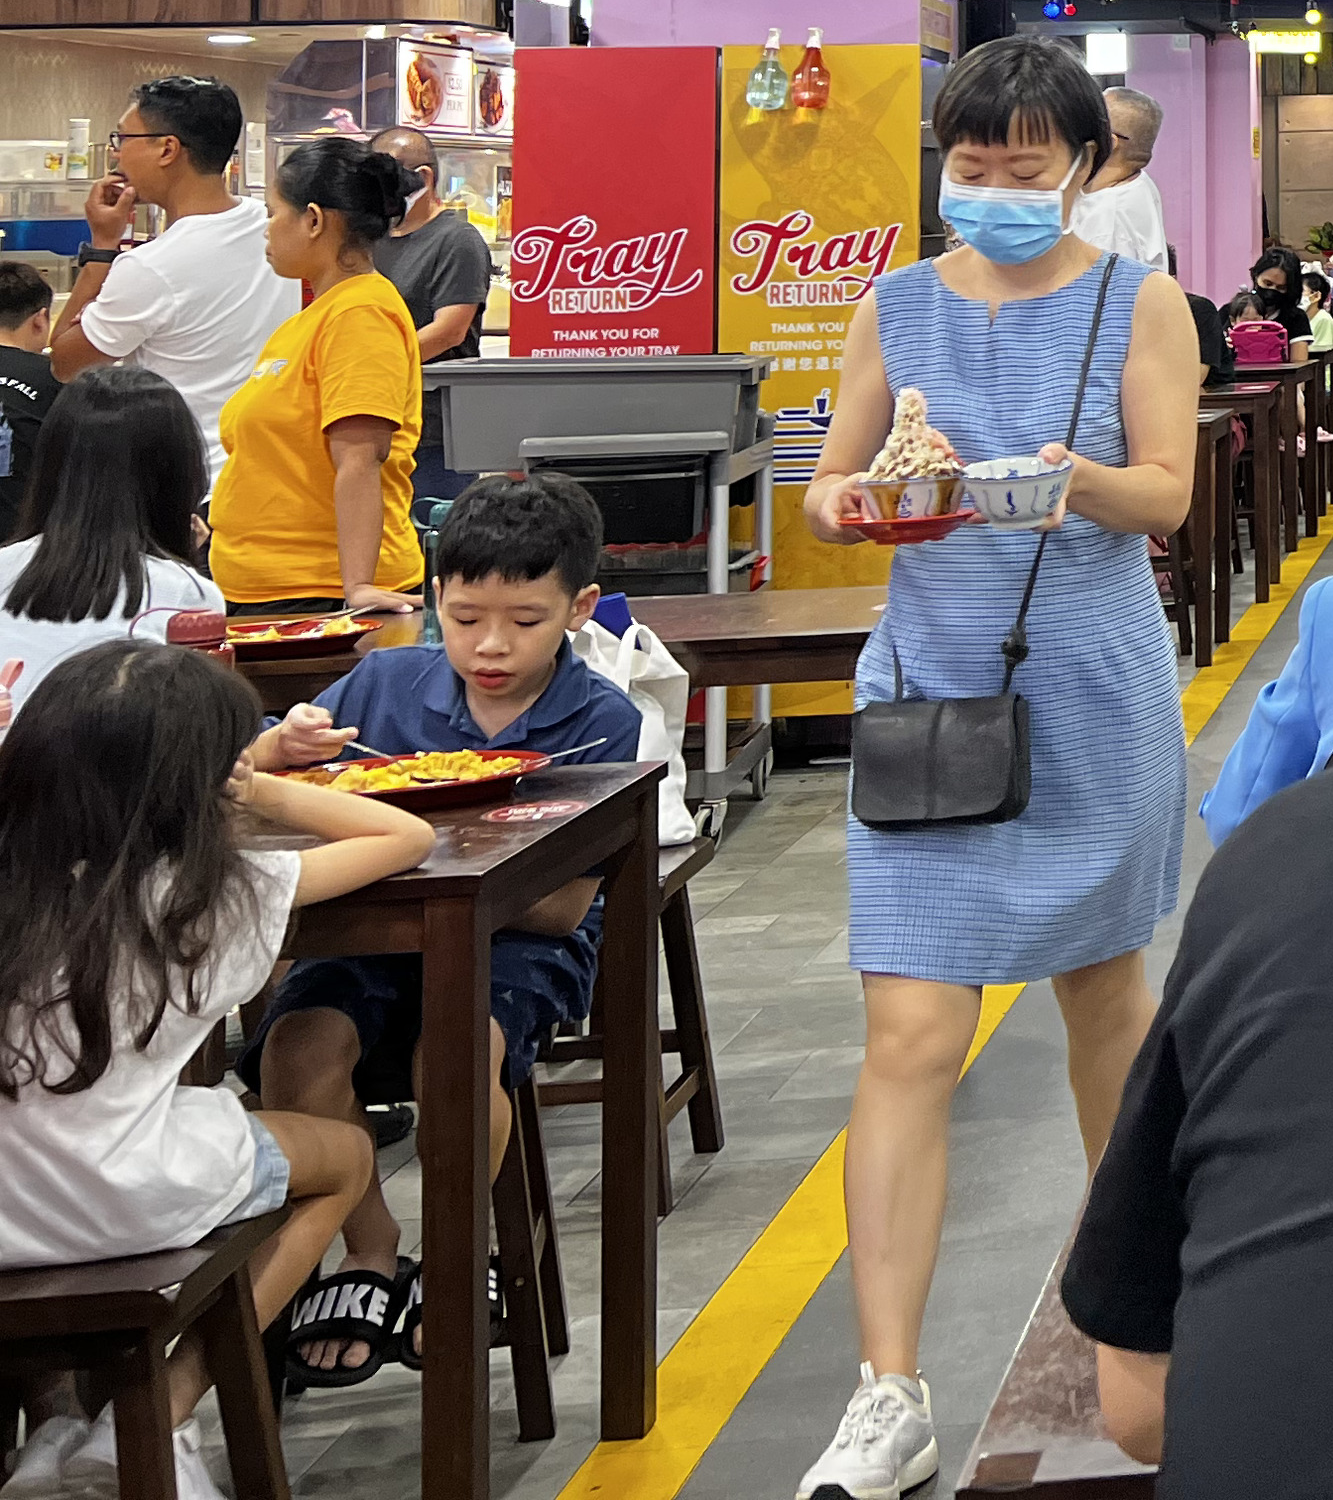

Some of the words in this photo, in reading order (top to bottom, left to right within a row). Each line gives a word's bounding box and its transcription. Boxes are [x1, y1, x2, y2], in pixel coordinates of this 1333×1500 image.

[511, 215, 703, 311] Tray
[730, 210, 903, 303] Tray
[549, 288, 629, 314] RETURN
[767, 282, 846, 307] RETURN
[553, 329, 599, 342] THANK
[600, 328, 629, 340] YOU
[632, 328, 659, 340] FOR
[771, 323, 815, 334] THANK
[818, 322, 845, 333] YOU
[531, 347, 606, 358] RETURNING
[609, 346, 646, 357] YOUR
[648, 345, 680, 356] TRAY
[750, 340, 823, 351] RETURNING
[826, 339, 845, 350] YO
[291, 1283, 390, 1331] NIKE
